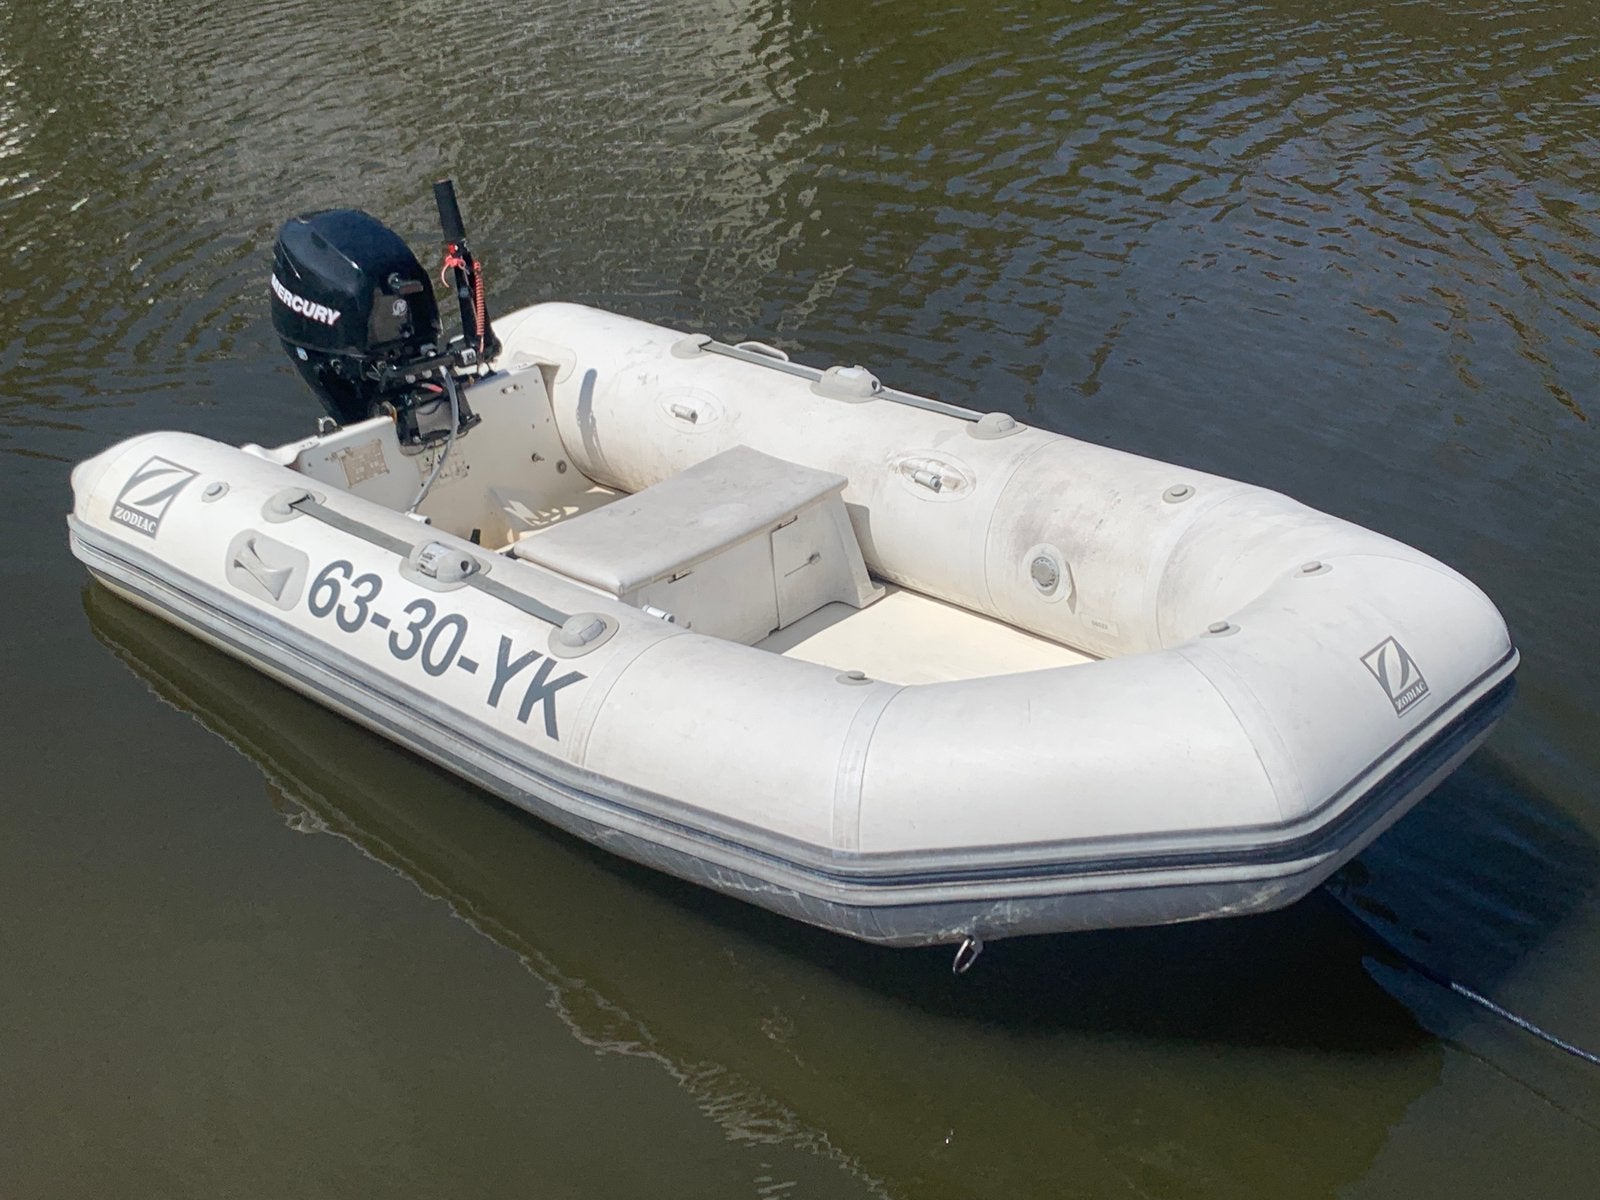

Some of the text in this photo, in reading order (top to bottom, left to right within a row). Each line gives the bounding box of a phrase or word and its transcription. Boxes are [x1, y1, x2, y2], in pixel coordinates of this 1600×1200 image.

[271, 272, 341, 326] MERCURY
[113, 505, 157, 534] ZODIAC
[308, 559, 588, 742] 63-30-YK
[1395, 681, 1427, 711] ZODIAC
